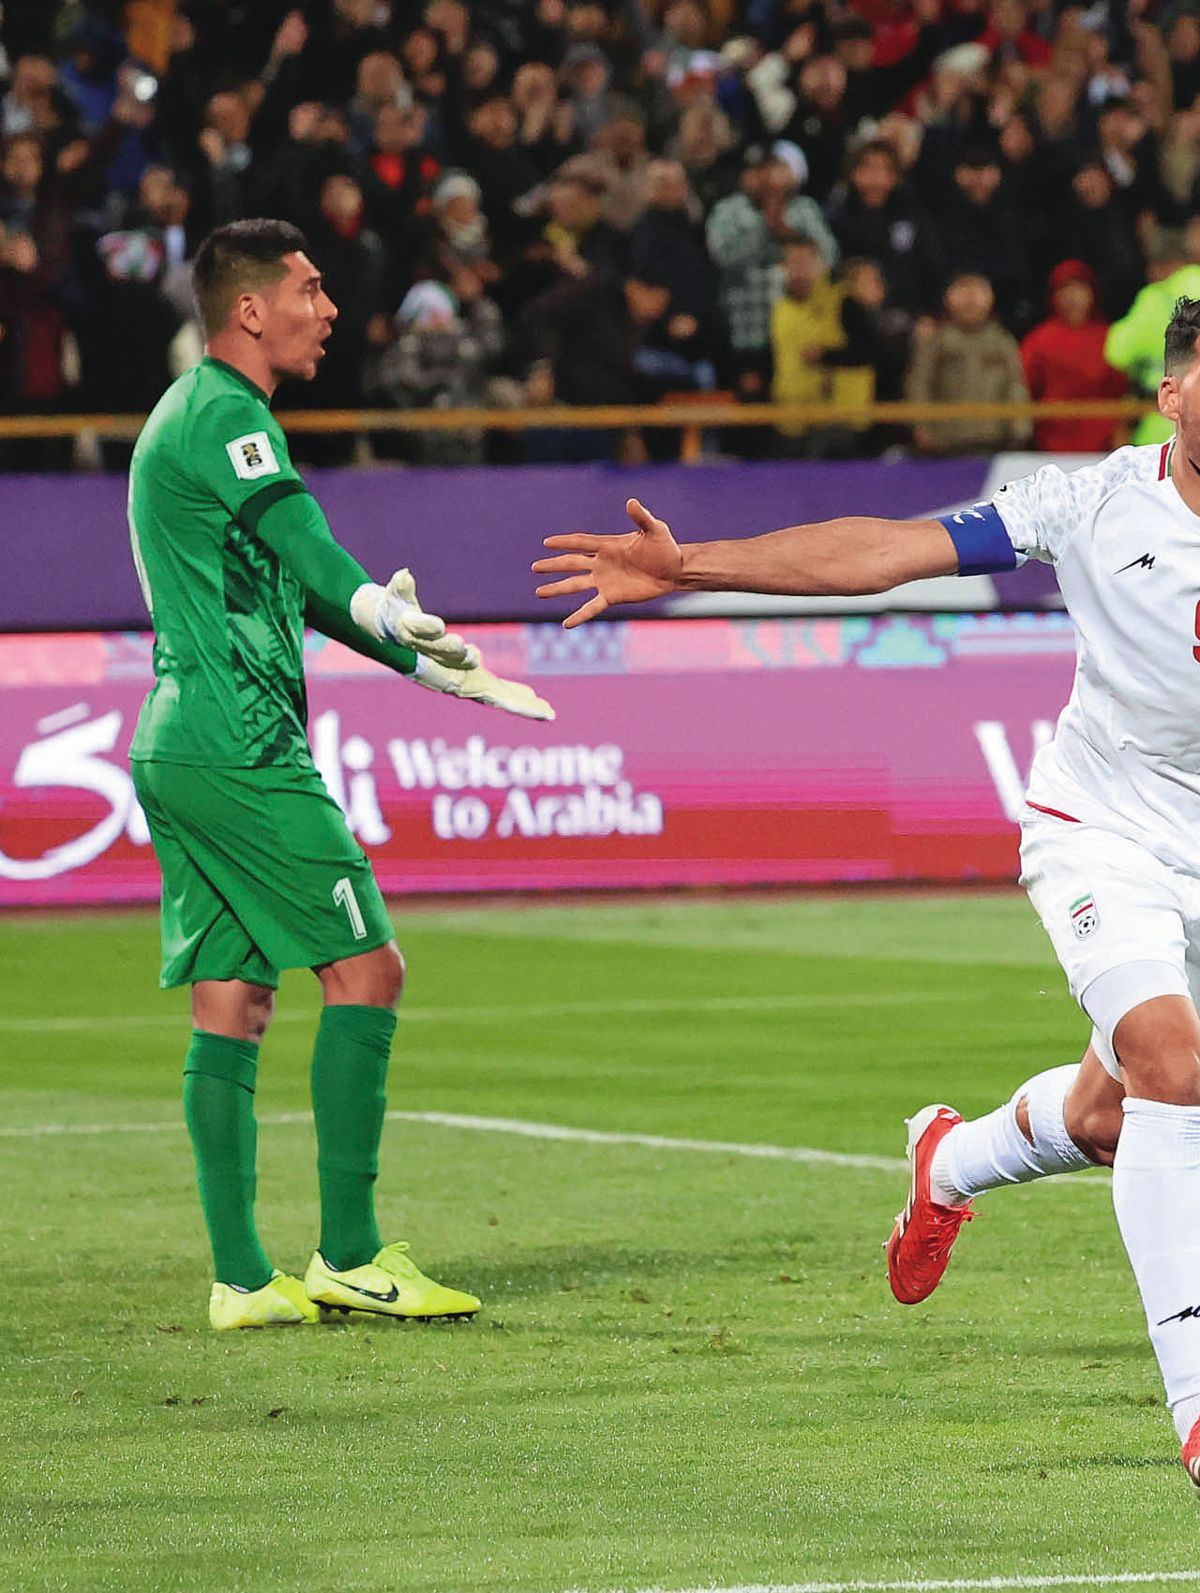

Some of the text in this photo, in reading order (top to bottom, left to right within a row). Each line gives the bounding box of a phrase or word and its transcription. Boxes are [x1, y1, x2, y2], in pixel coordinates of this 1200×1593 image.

[388, 735, 624, 789] Welcome
[432, 780, 664, 840] to Arabia
[332, 877, 367, 940] 1
